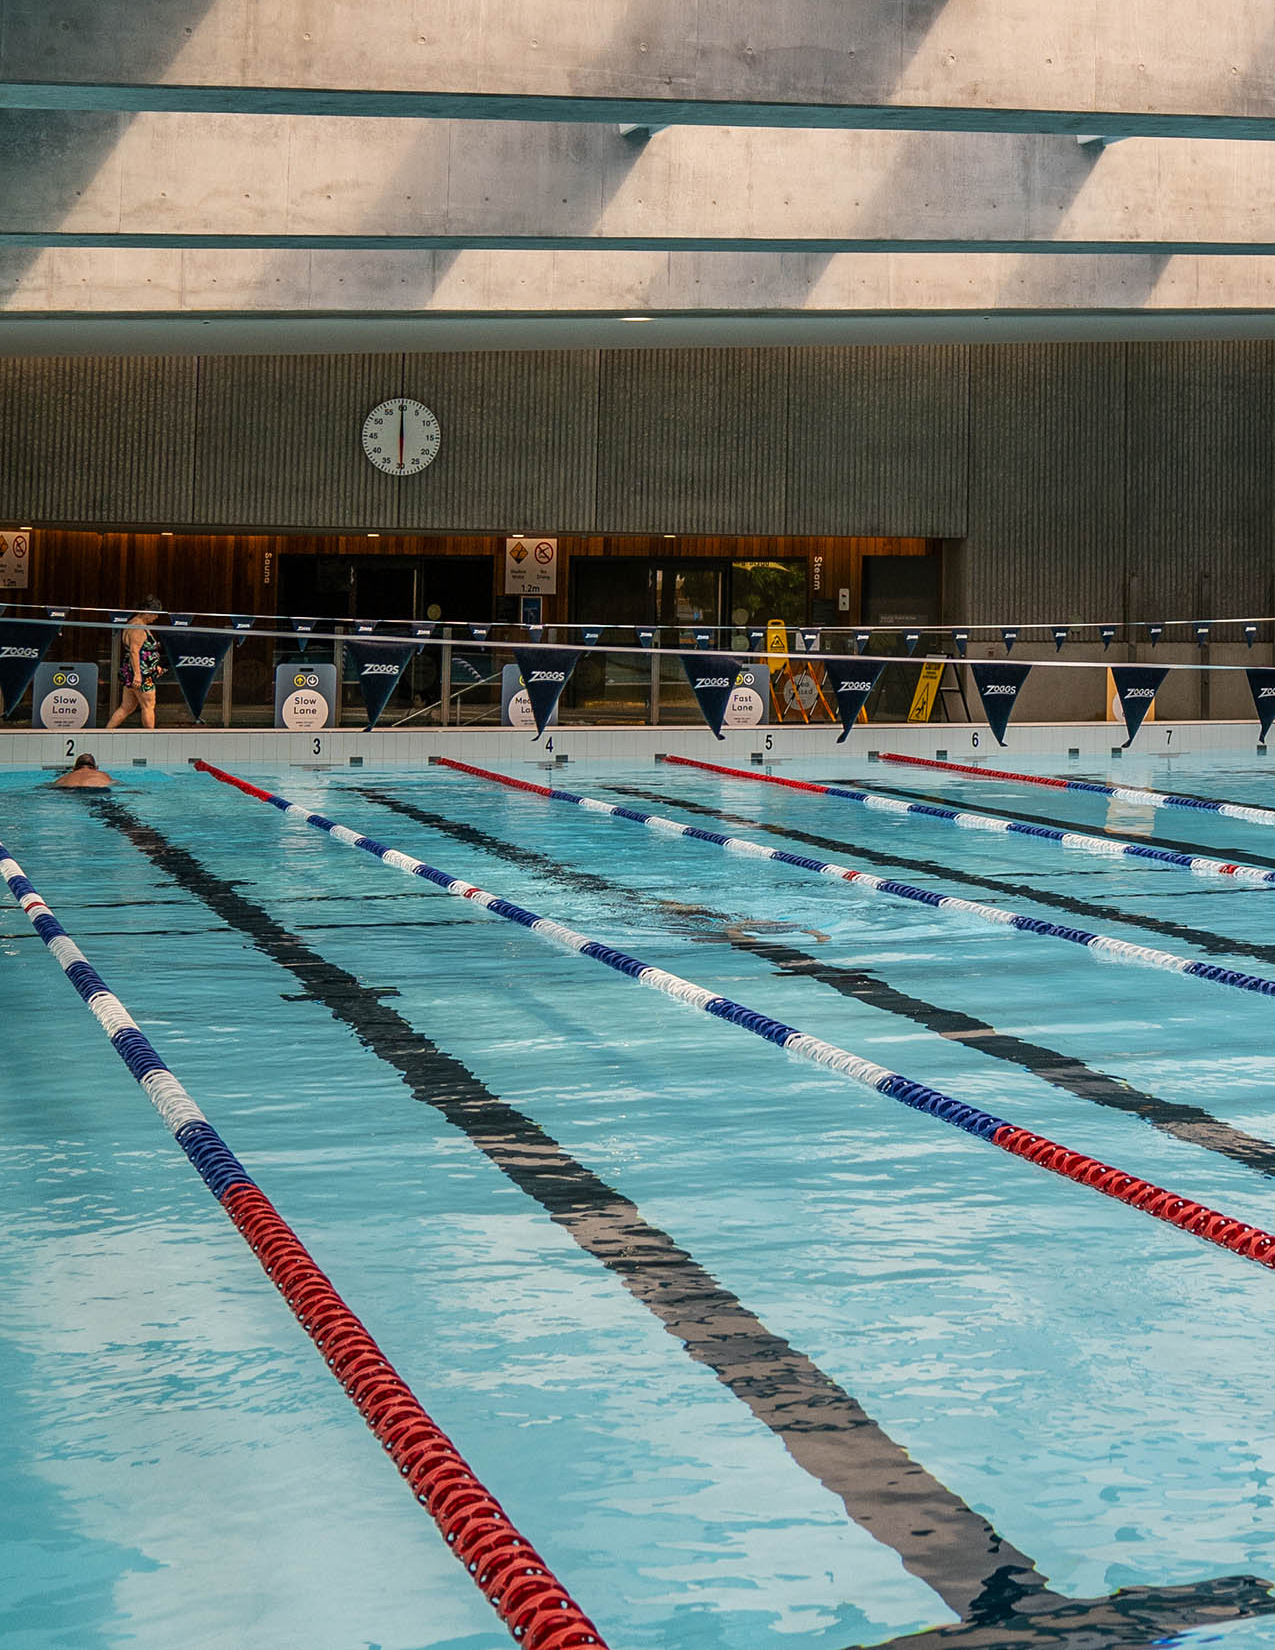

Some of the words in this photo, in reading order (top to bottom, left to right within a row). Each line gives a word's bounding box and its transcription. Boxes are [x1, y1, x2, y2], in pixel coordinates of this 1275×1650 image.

[264, 552, 273, 583] Sauna
[814, 556, 823, 590] Steam
[521, 584, 540, 592] 1.2m
[0, 647, 39, 658] ZOGGS
[176, 656, 215, 667] ZOGGS
[361, 664, 400, 675] ZOGGS
[528, 671, 565, 683] ZOGGS
[694, 678, 729, 689] ZOGGS
[837, 682, 871, 692] ZOGGS
[984, 685, 1017, 695] ZOGGS
[1124, 688, 1155, 699] ZOGGS
[53, 695, 77, 704] Slow
[294, 696, 317, 705] Slow
[52, 706, 77, 714] Lane
[294, 707, 317, 715] Lane
[765, 734, 772, 750] 5
[972, 732, 979, 747] 6
[1166, 730, 1172, 744] 7
[66, 739, 75, 756] 2
[313, 738, 321, 754] 3
[545, 736, 553, 753] 4
